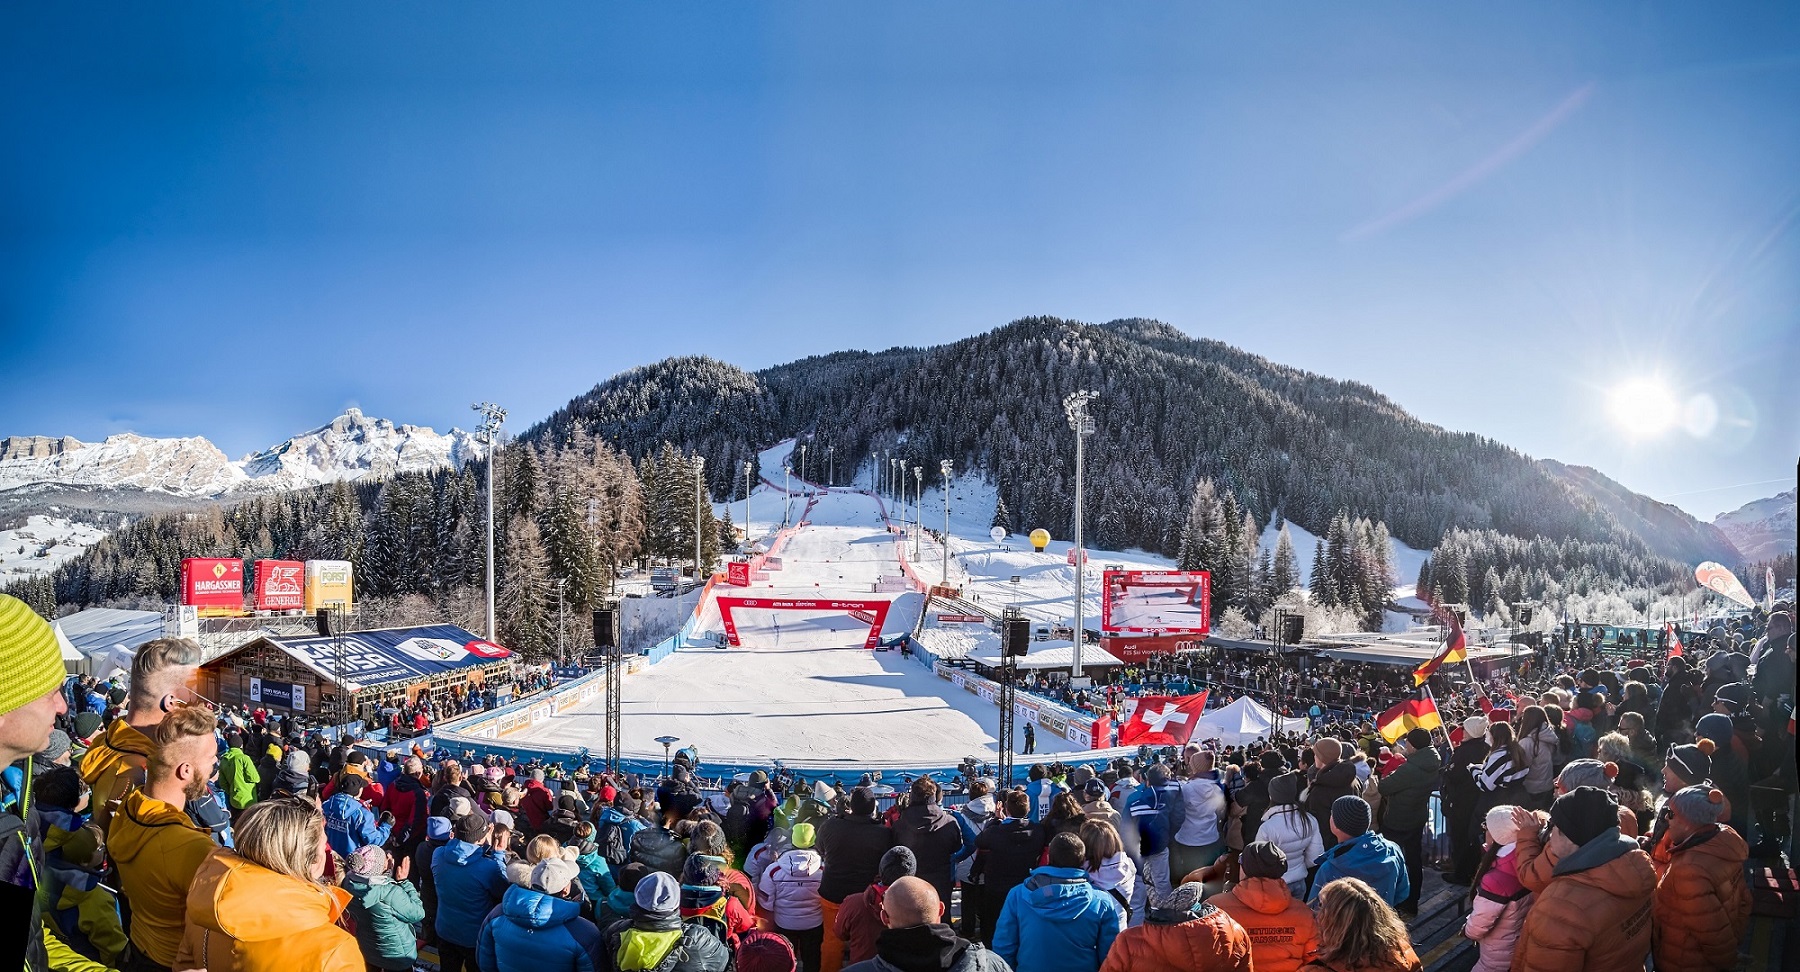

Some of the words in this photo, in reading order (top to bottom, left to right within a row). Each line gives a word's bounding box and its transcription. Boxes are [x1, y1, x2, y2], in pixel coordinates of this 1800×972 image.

[322, 571, 346, 582] FORST
[195, 580, 241, 590] HARGASSNER
[265, 596, 300, 605] GENERALI
[501, 720, 514, 730] FORST
[1247, 927, 1295, 935] EITINGER
